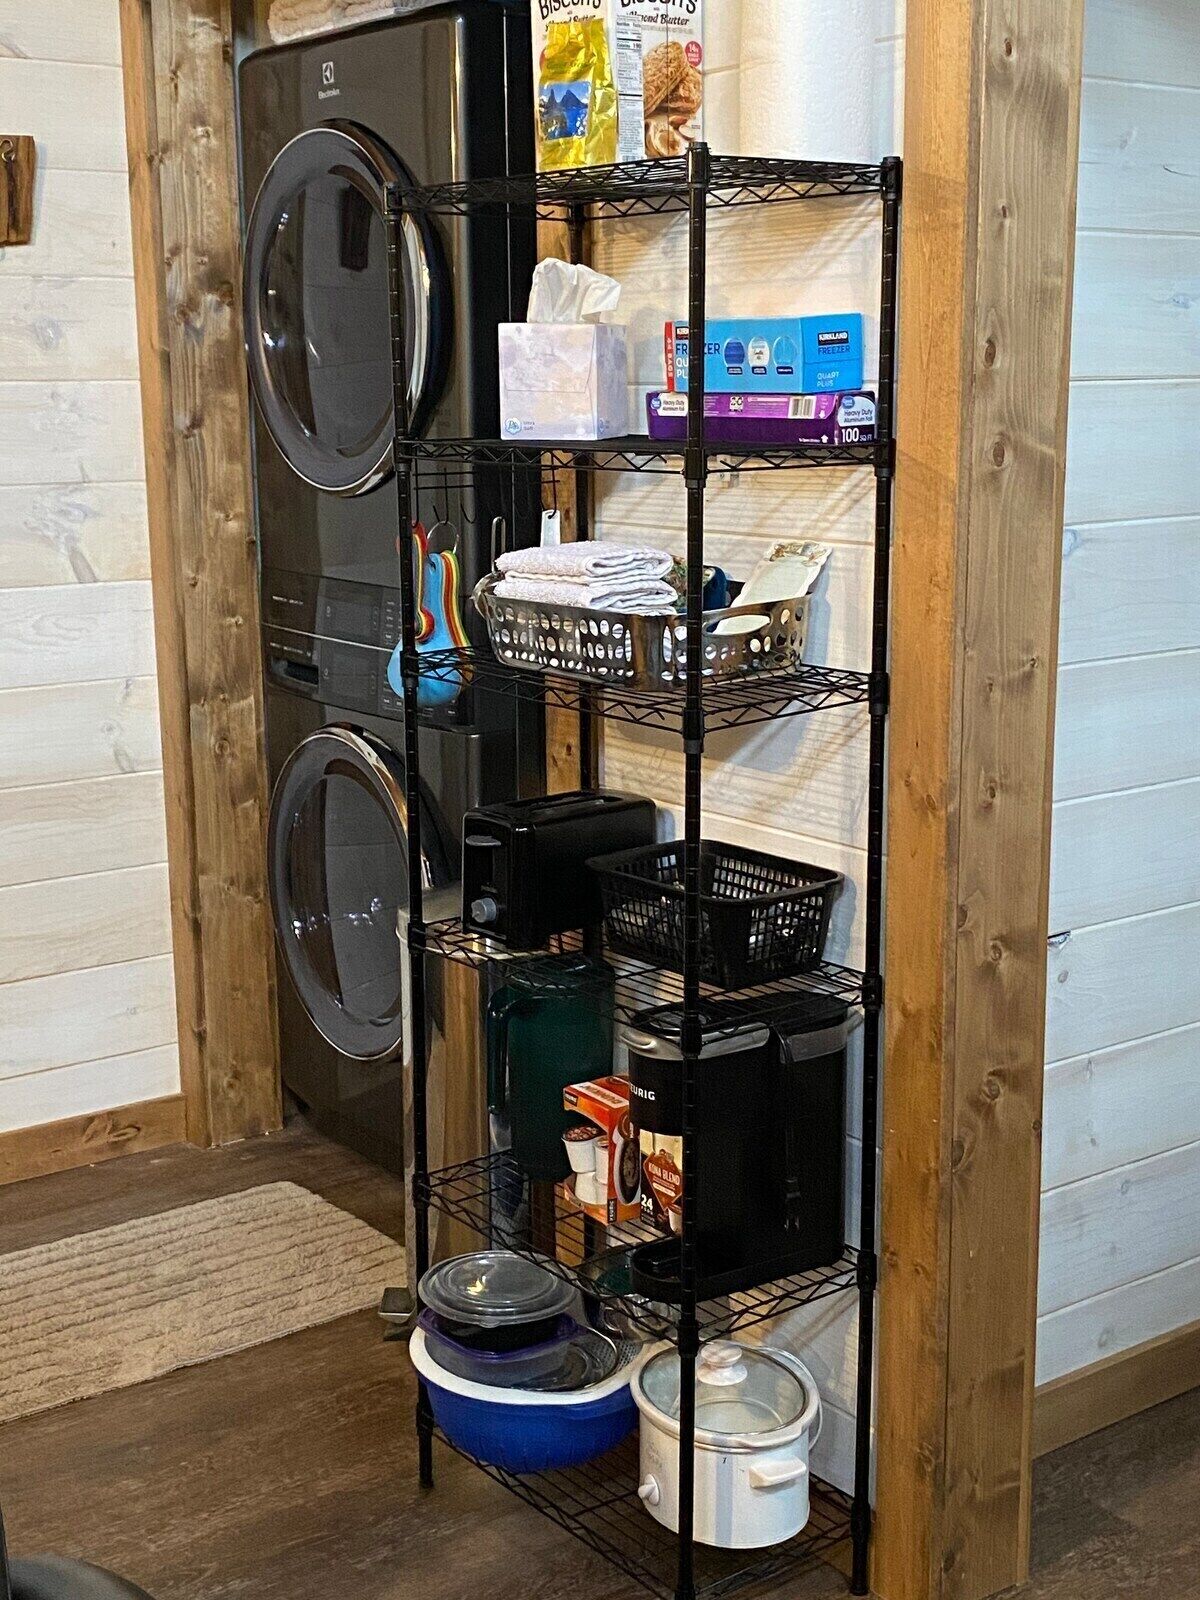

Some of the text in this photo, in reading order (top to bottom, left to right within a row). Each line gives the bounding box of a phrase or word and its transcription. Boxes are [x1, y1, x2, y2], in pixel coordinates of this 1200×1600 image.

[661, 14, 690, 26] Butter
[318, 88, 340, 99] Electrolux
[819, 332, 848, 340] KIRKLAND
[675, 343, 721, 355] FRZER
[818, 345, 850, 355] FREEZER
[676, 369, 688, 378] PL
[817, 371, 840, 380] QUART
[841, 427, 860, 443] 100
[630, 1083, 656, 1101] EURIG
[662, 1169, 680, 1186] BLEND
[641, 1193, 653, 1211] 24
